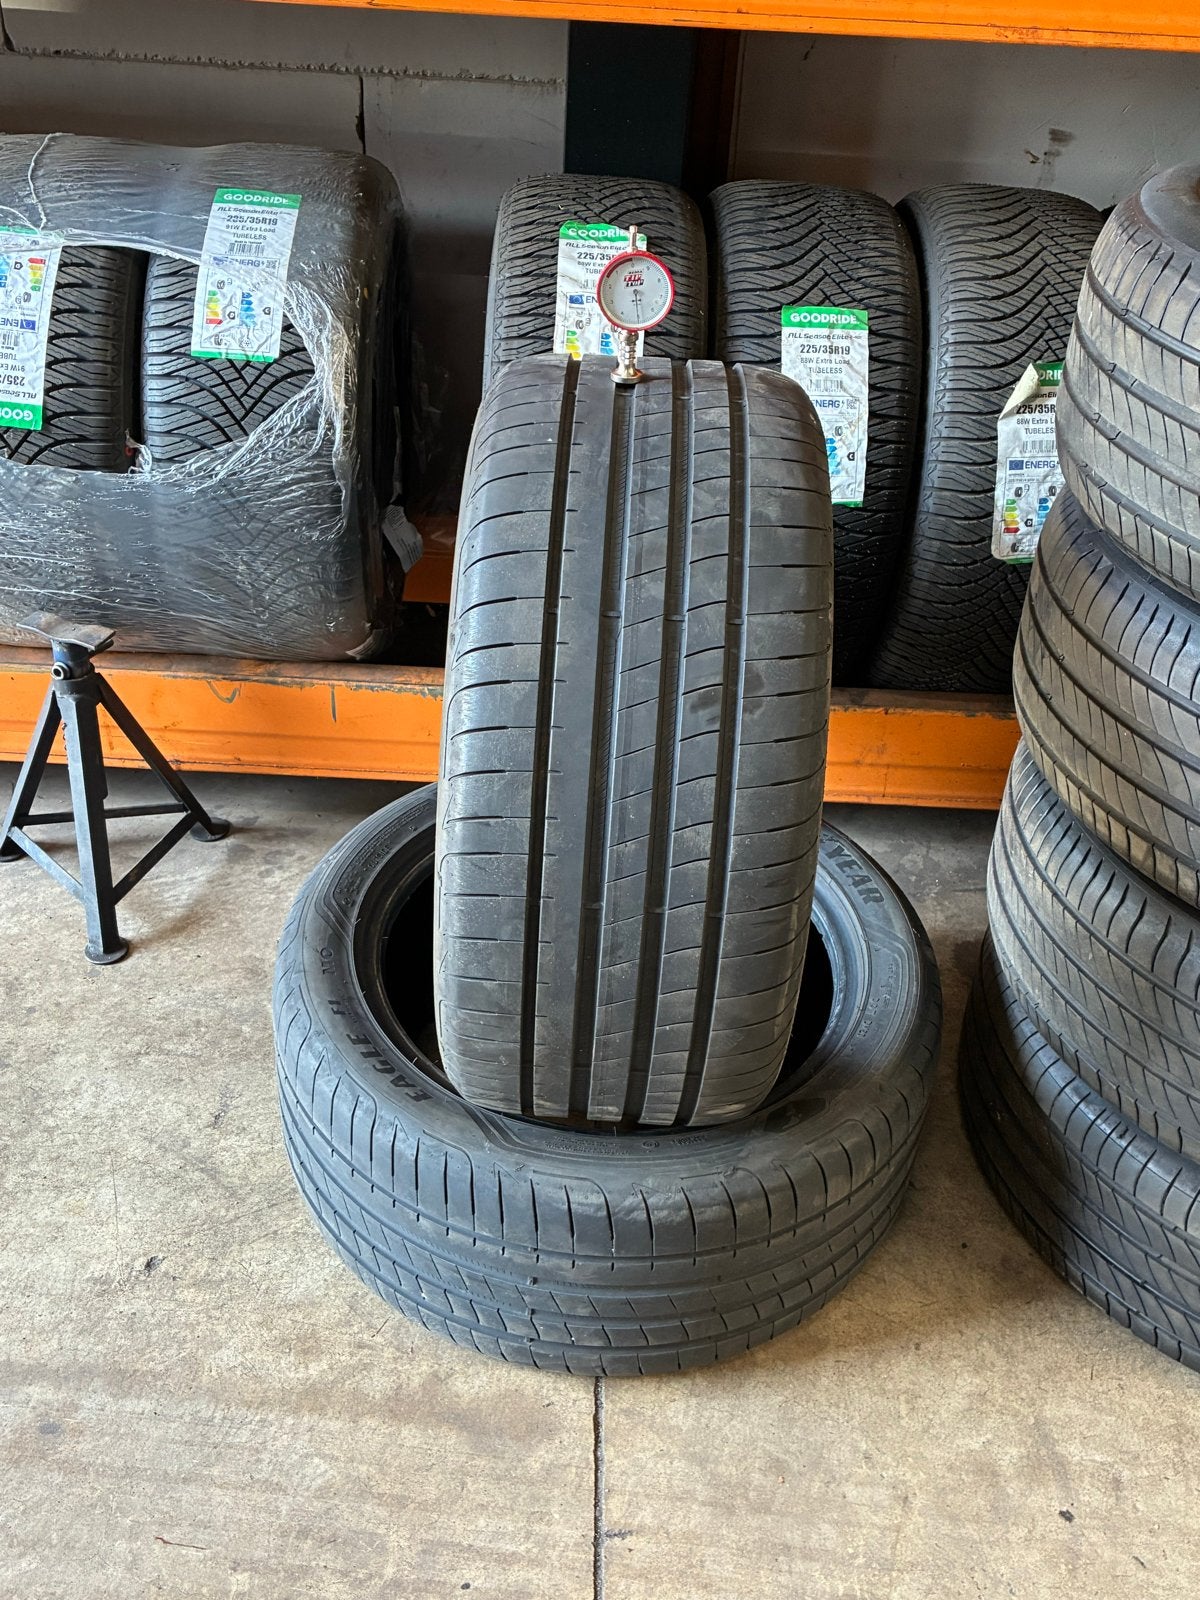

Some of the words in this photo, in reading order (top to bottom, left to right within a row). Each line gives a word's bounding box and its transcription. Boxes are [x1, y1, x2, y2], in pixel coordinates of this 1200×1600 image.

[223, 193, 289, 205] GOODRIDE
[226, 214, 278, 226] 235/35R19
[232, 232, 267, 241] TUBELESS
[568, 227, 628, 238] GOODRI
[576, 251, 617, 261] 225/35
[585, 267, 602, 275] TUBE
[790, 312, 858, 324] GOODRIDE
[799, 344, 851, 355] 225/35R19
[11, 364, 25, 372] 91W
[808, 366, 843, 374] TUBELESS
[0, 374, 25, 387] 235/
[812, 399, 841, 408] NERG
[1016, 404, 1056, 414] 225/35R
[1031, 417, 1049, 425] Extra
[1024, 427, 1056, 435] TUBELES
[1024, 460, 1056, 469] ENERG
[346, 1033, 433, 1102] EAGLE
